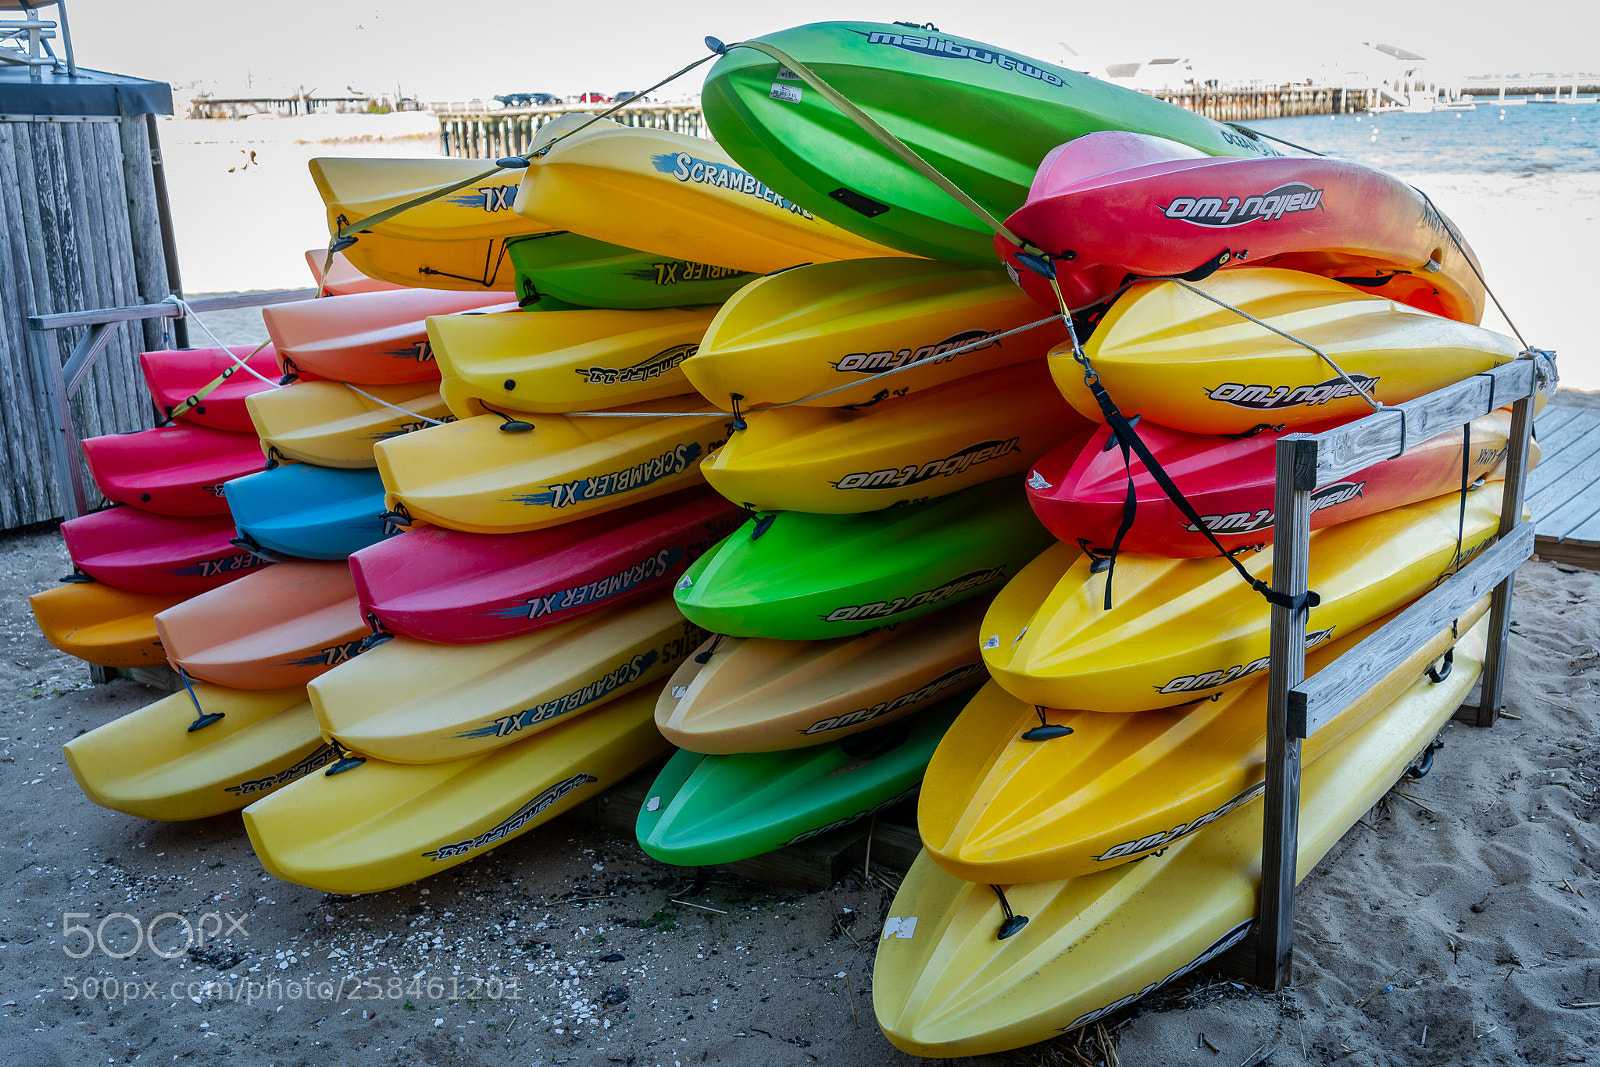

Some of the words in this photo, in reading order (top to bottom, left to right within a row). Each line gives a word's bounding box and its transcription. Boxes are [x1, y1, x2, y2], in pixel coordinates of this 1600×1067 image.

[478, 185, 509, 212] XL
[1164, 196, 1240, 224] two
[1238, 189, 1324, 222] malibu
[652, 261, 679, 286] XL
[1208, 383, 1291, 408] two
[916, 437, 1021, 478] malibu
[583, 444, 688, 498] SCRAMBLER
[835, 465, 918, 489] two
[549, 480, 579, 508] XL
[197, 558, 223, 577] XL
[560, 549, 669, 607] SCRAMBLER
[527, 593, 557, 619] XL
[824, 597, 906, 622] two
[321, 642, 352, 666] XL
[530, 655, 644, 723] SCRAMBLER
[496, 711, 528, 737] XL
